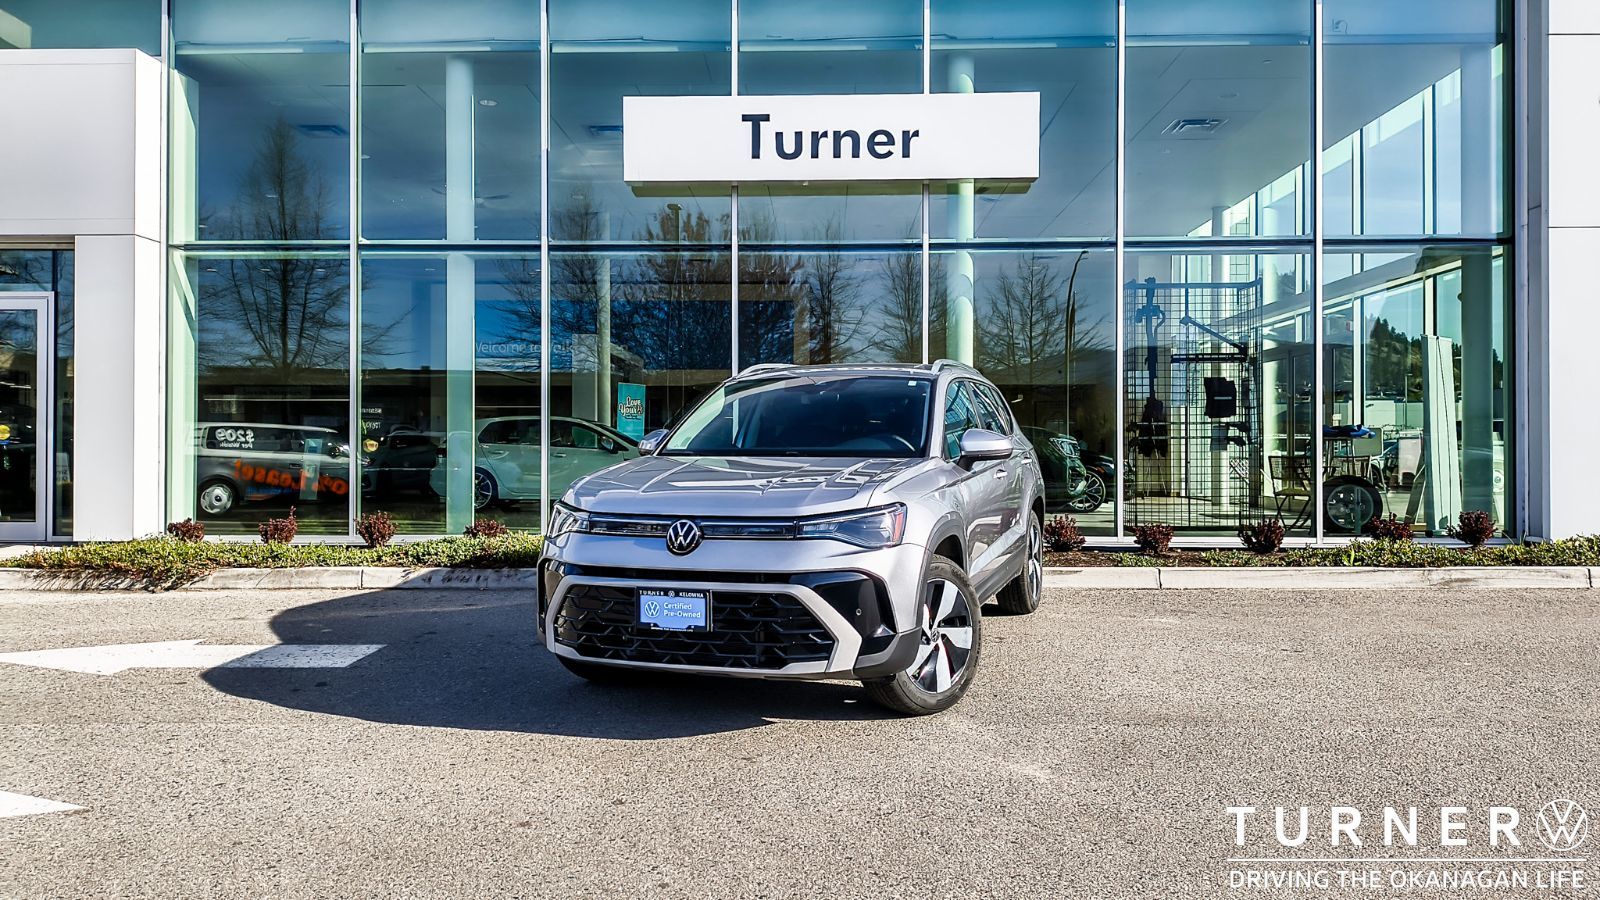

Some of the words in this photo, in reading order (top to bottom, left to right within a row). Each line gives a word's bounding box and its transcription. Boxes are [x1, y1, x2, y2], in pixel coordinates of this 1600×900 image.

[741, 113, 920, 161] Turner
[626, 395, 641, 407] Love
[663, 602, 692, 610] Certified
[663, 610, 701, 618] Pre-Owned
